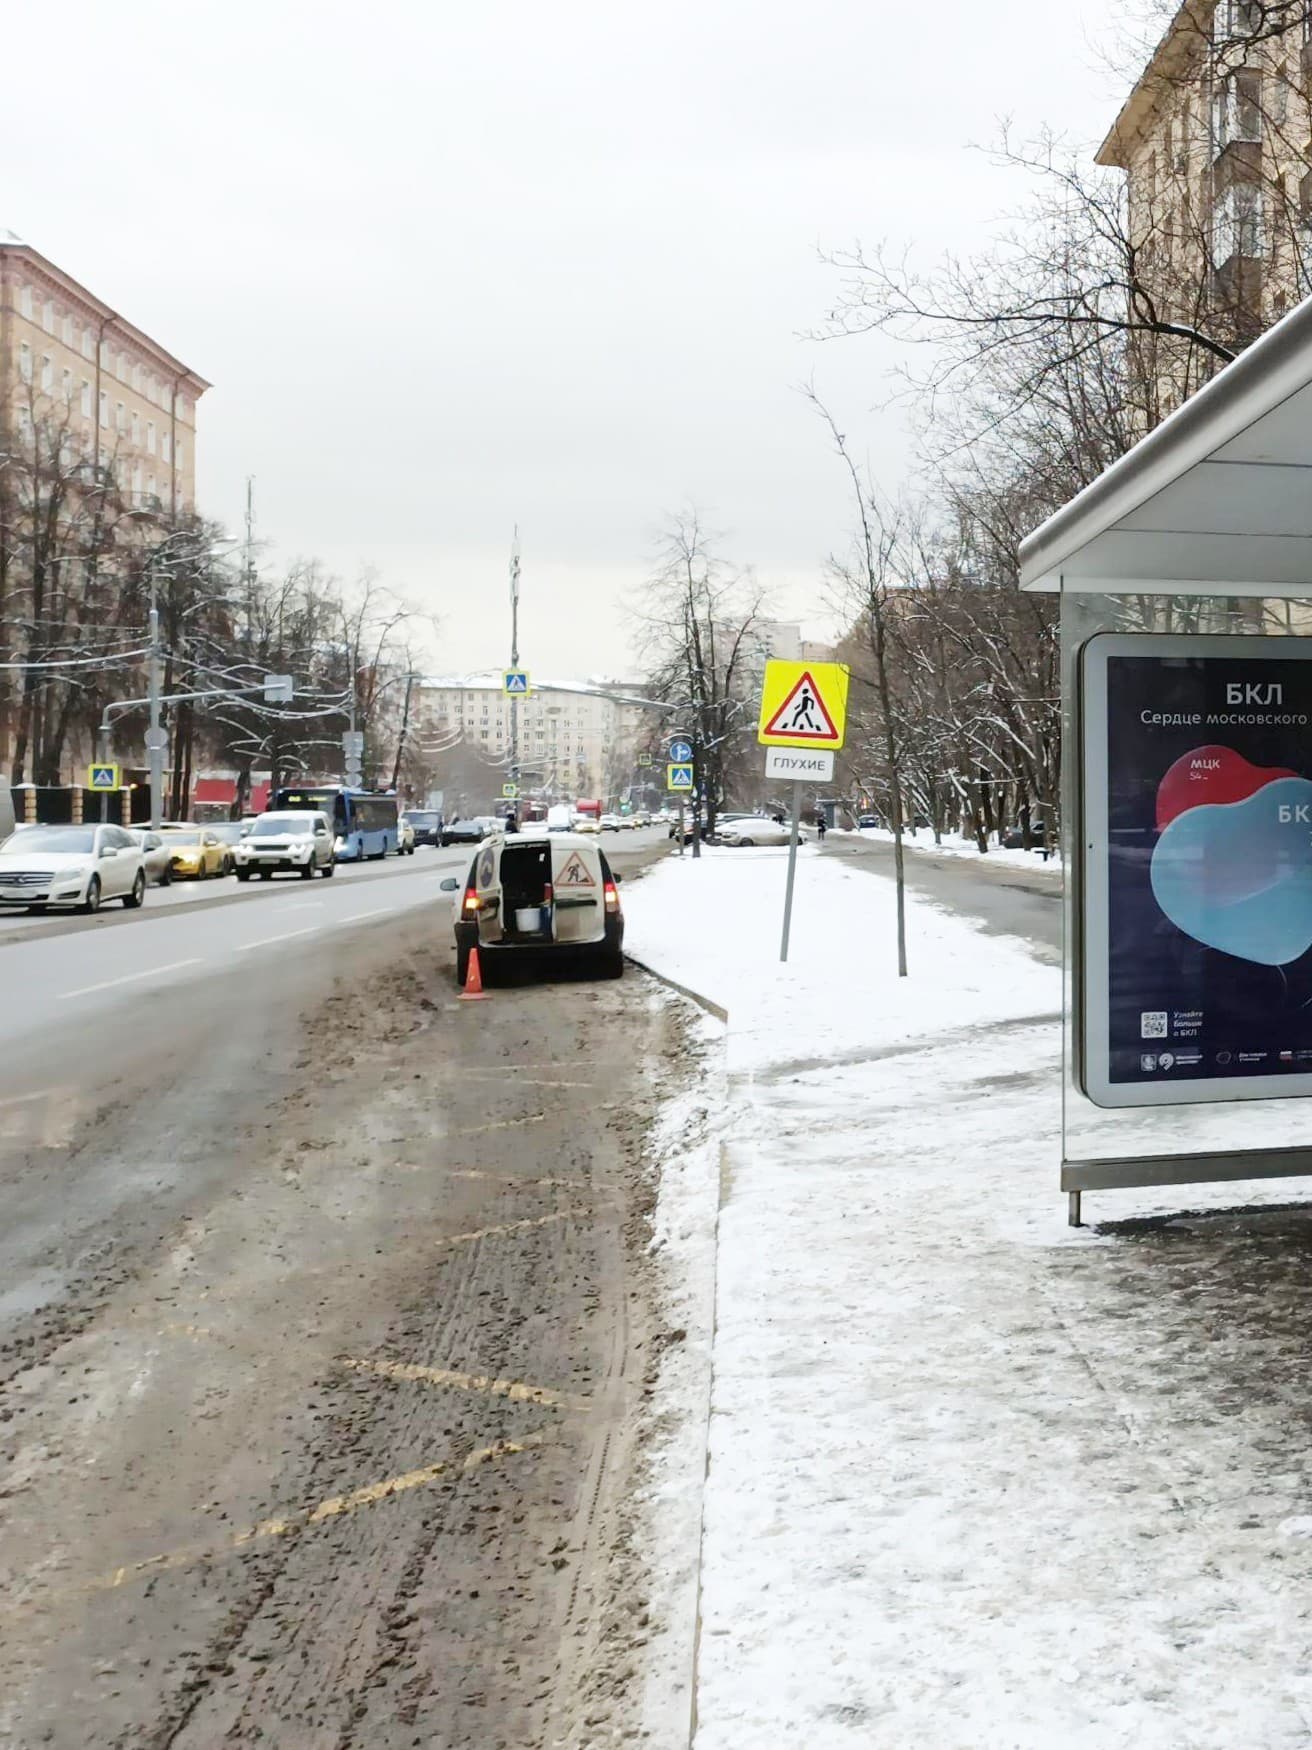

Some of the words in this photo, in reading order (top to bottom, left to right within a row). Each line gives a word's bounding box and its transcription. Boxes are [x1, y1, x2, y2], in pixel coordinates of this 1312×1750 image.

[1226, 683, 1282, 705] БКЛ
[1140, 709, 1201, 727] Сердце
[1206, 714, 1307, 725] московского
[774, 757, 826, 771] ГЛУХИЕ
[1190, 759, 1220, 770] МЦК
